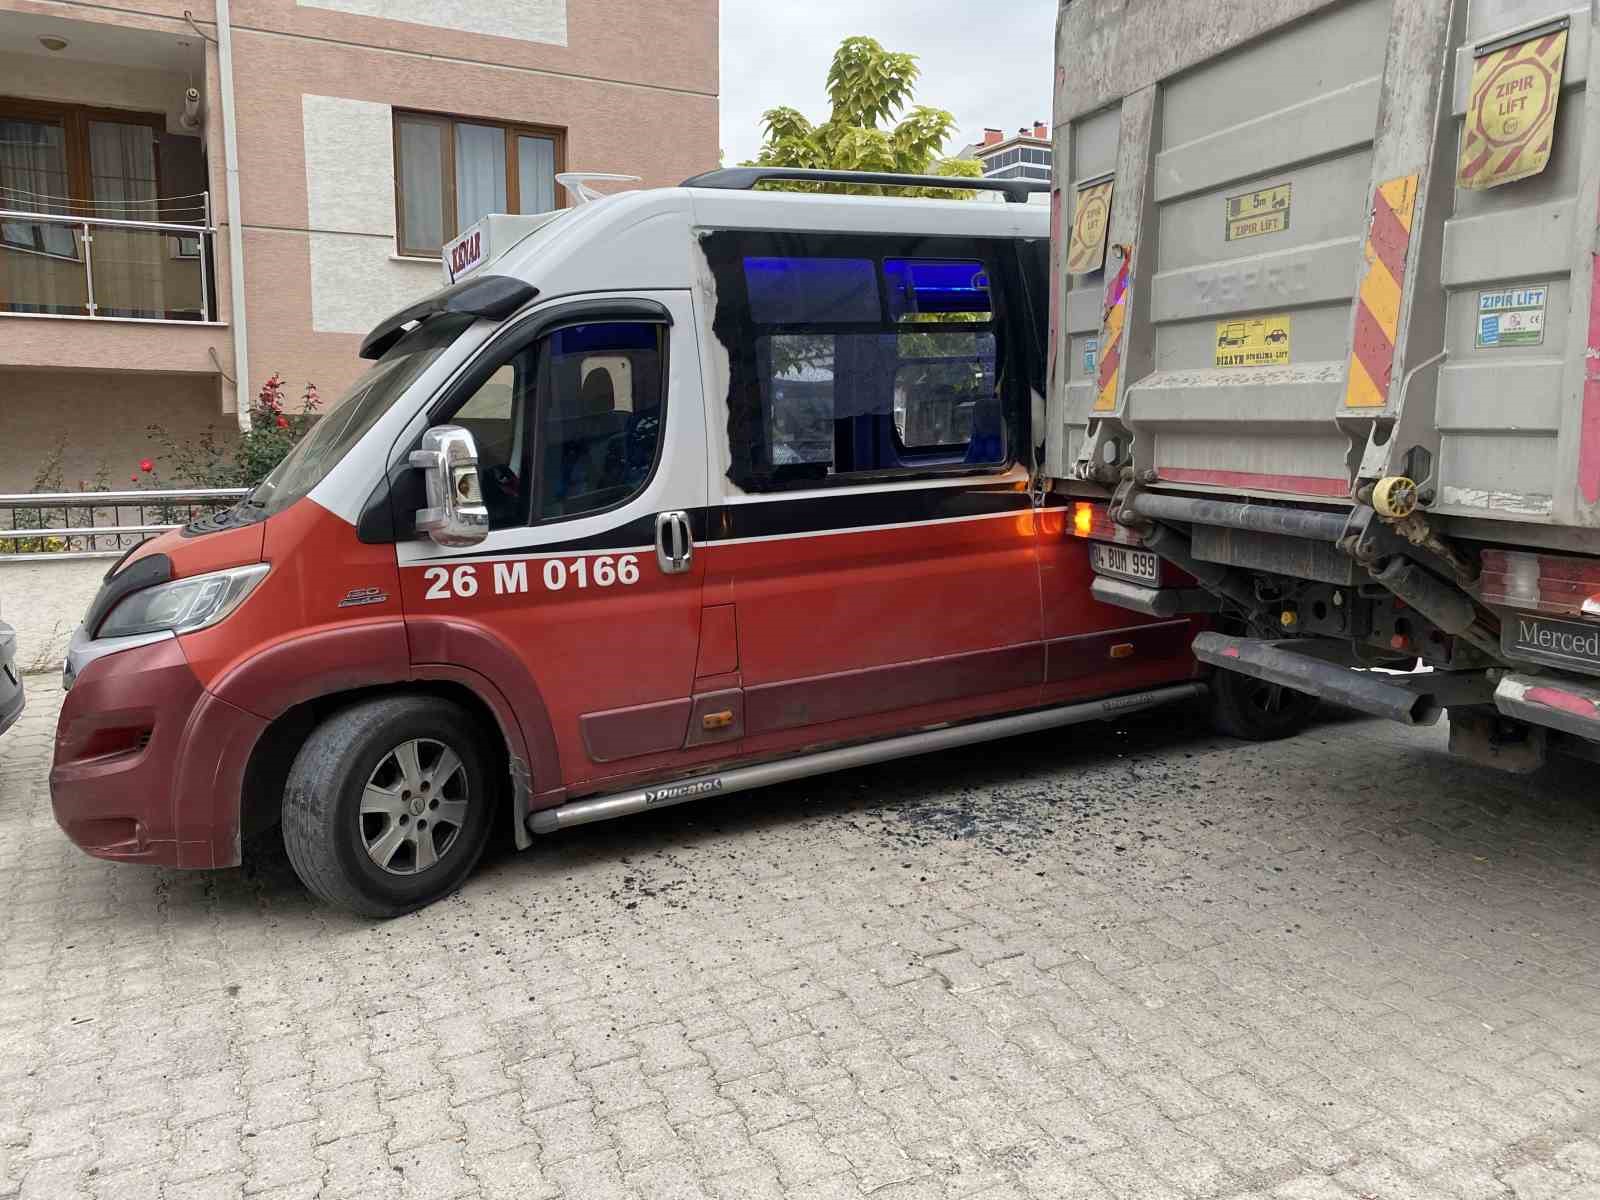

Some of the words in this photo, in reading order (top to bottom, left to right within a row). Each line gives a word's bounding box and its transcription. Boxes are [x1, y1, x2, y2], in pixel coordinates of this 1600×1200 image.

[1495, 74, 1535, 99] ZIPIR
[1482, 294, 1513, 309] ZIPIR
[1108, 547, 1128, 573] BUM
[1132, 553, 1155, 577] 999
[424, 565, 479, 600] 26
[493, 561, 529, 594] M
[543, 554, 640, 591] 0166
[656, 782, 713, 801] Ducato
